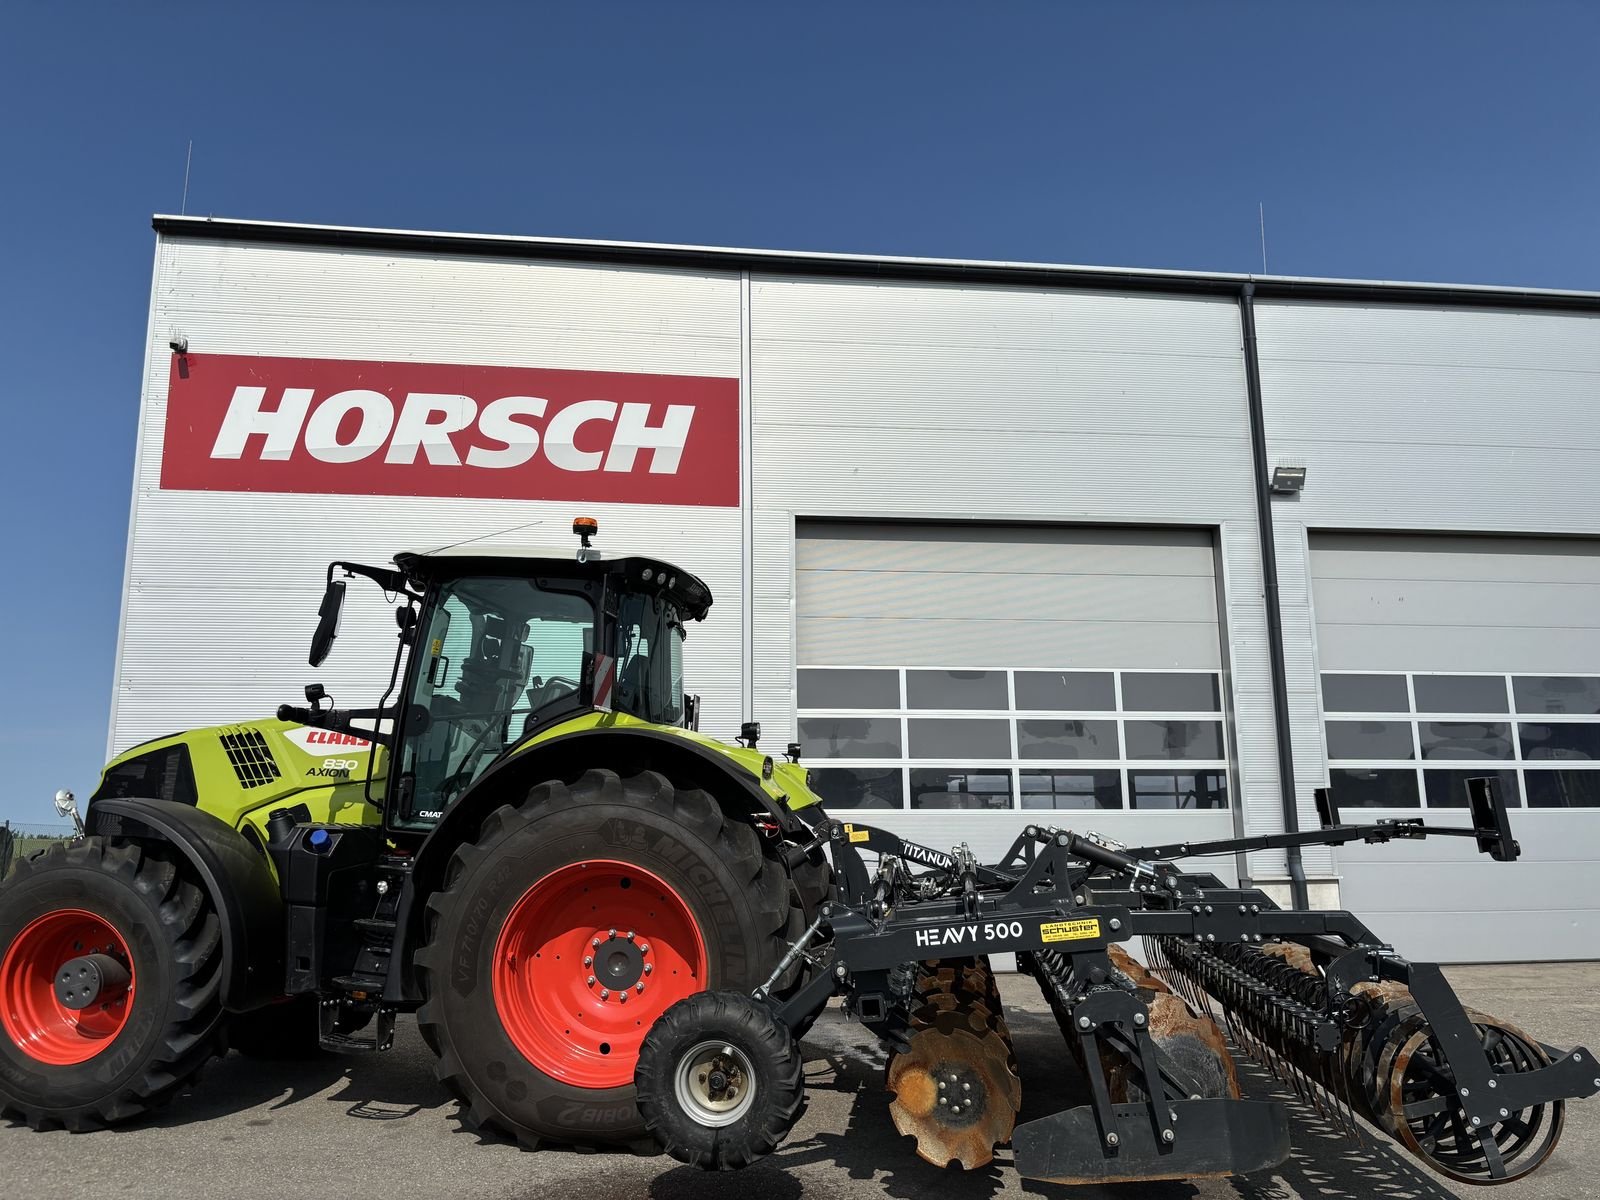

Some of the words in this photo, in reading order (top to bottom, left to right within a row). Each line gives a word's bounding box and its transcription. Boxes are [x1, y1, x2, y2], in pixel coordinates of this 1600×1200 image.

[210, 385, 696, 475] HORSCH
[306, 768, 350, 777] AXION
[323, 758, 358, 770] 830
[652, 834, 746, 985] MICHELIN
[915, 925, 978, 947] HEAVY
[984, 921, 1023, 940] 500
